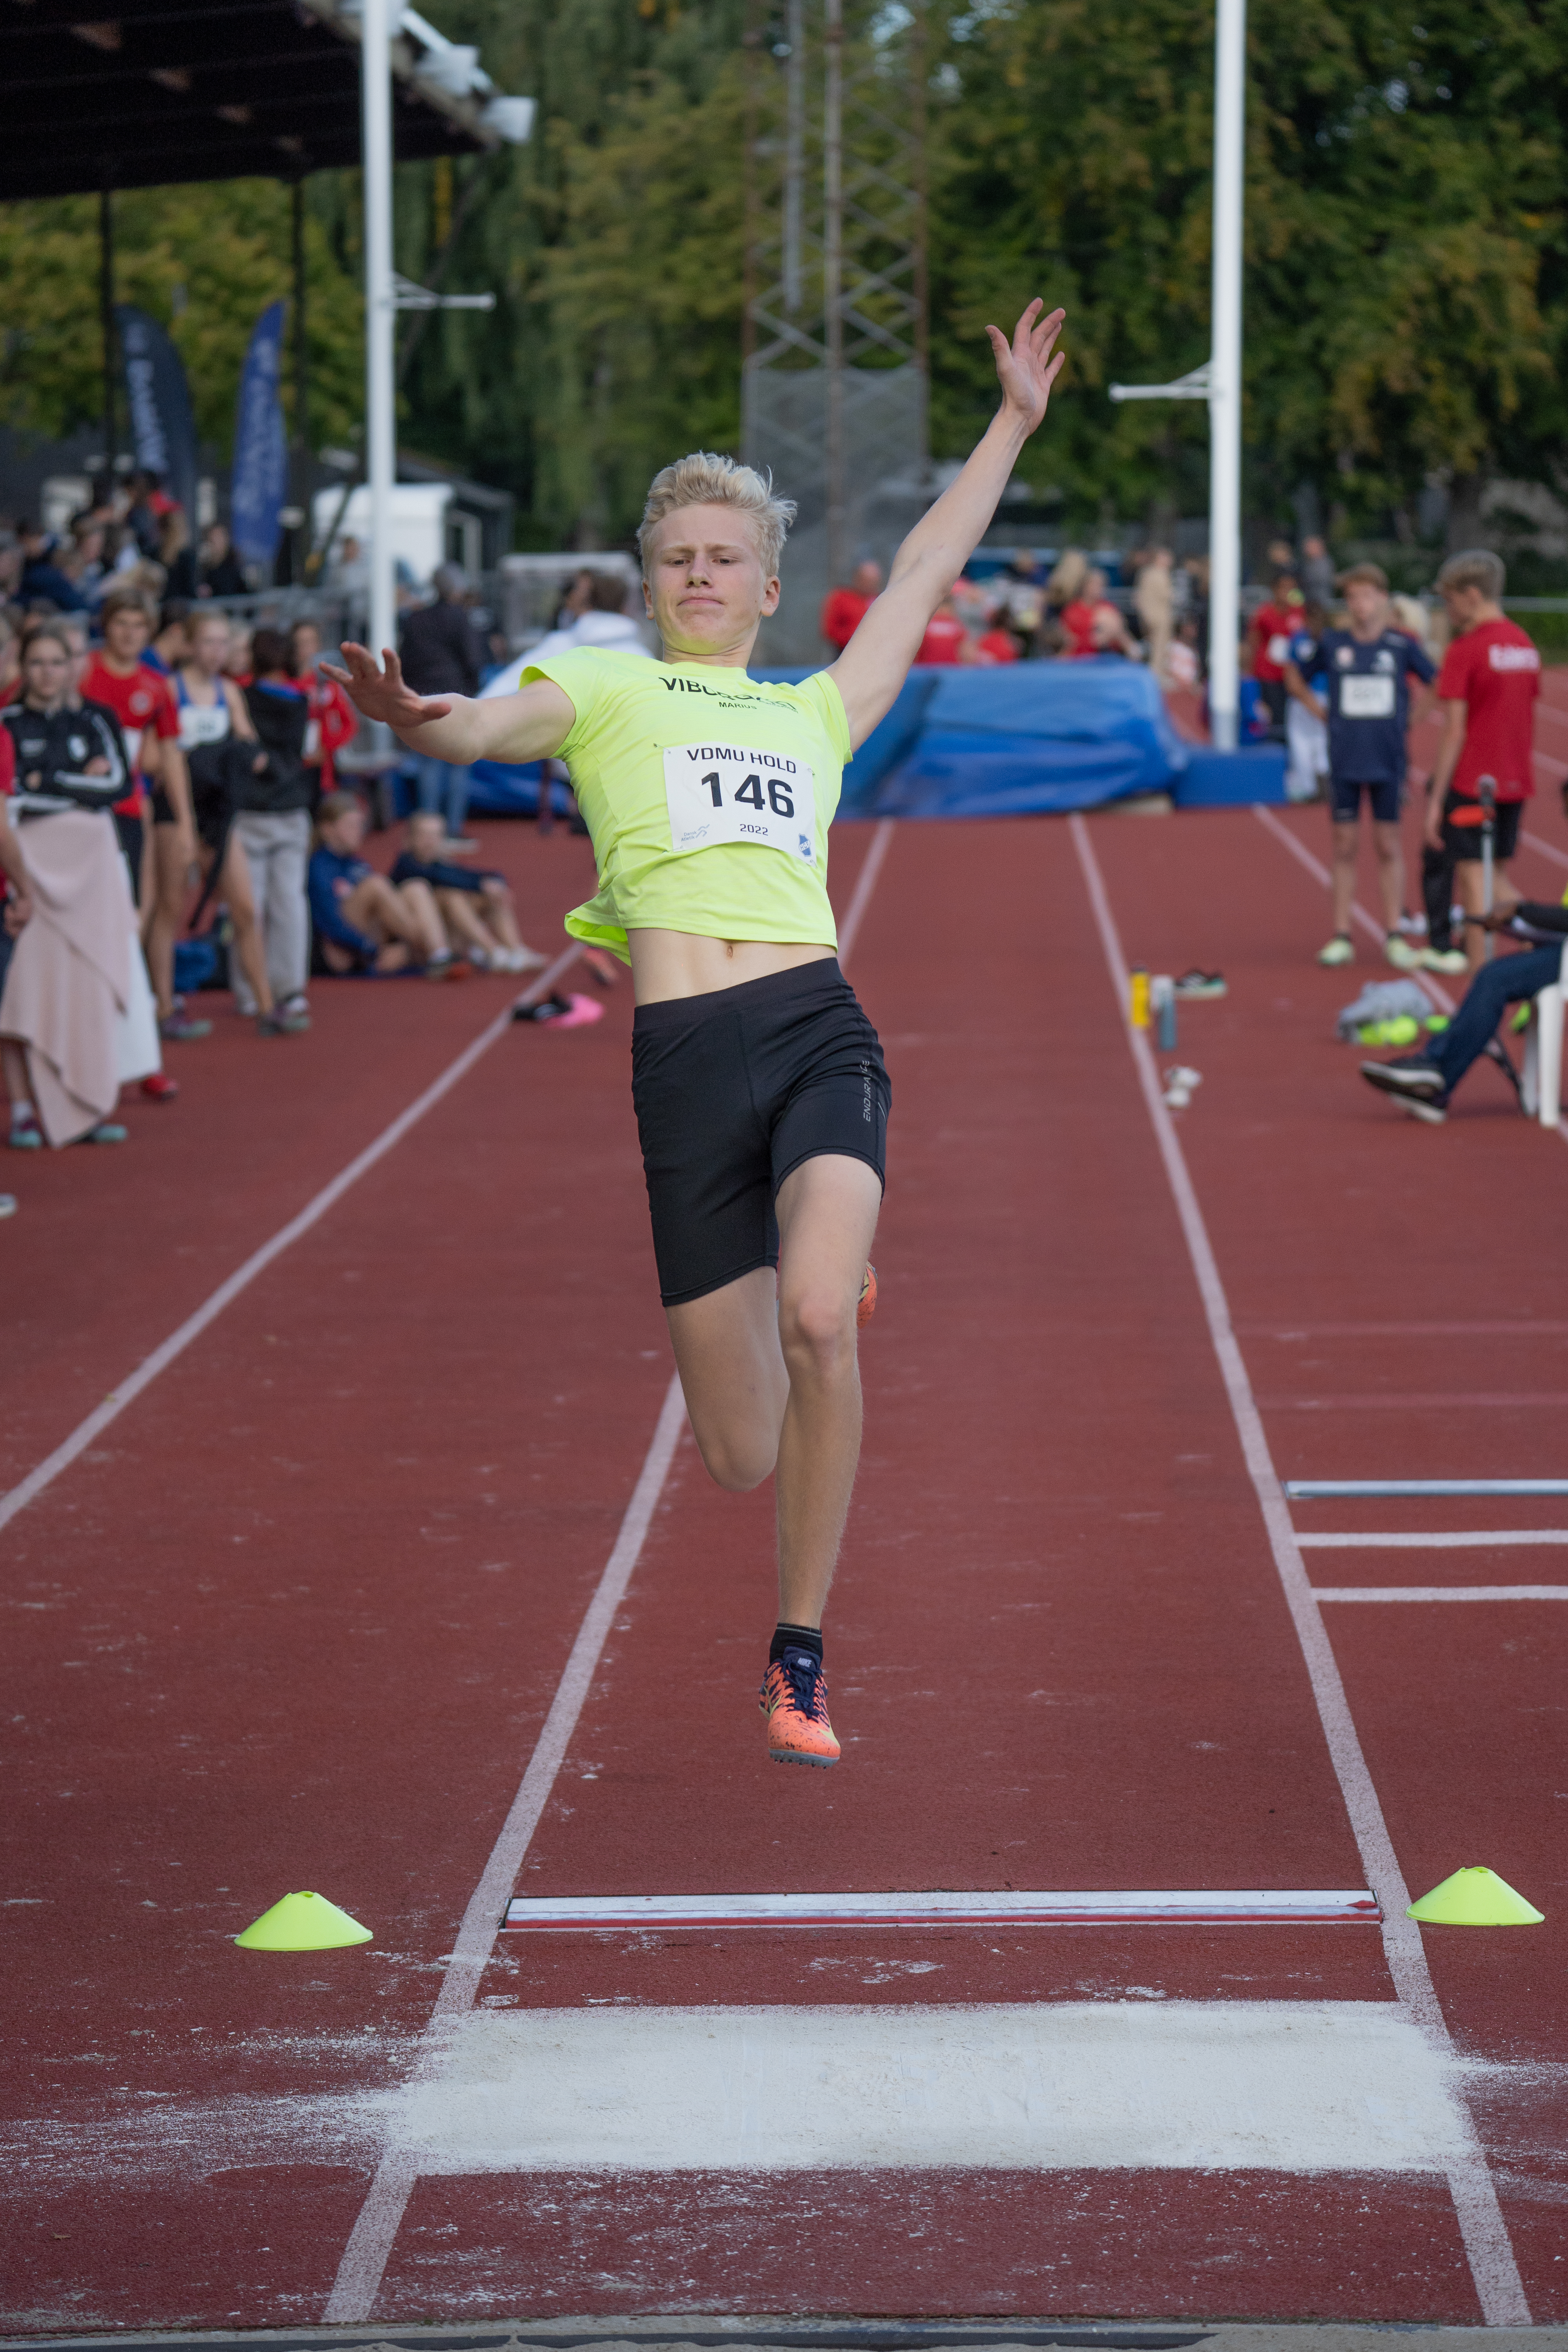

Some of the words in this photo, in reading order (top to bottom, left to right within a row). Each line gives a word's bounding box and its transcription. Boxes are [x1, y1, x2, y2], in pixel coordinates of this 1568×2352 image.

[686, 747, 744, 761] VDMU
[750, 752, 796, 773] HOLD
[701, 772, 794, 818] 146
[740, 824, 768, 836] 2022
[797, 1657, 812, 1668] NIKE
